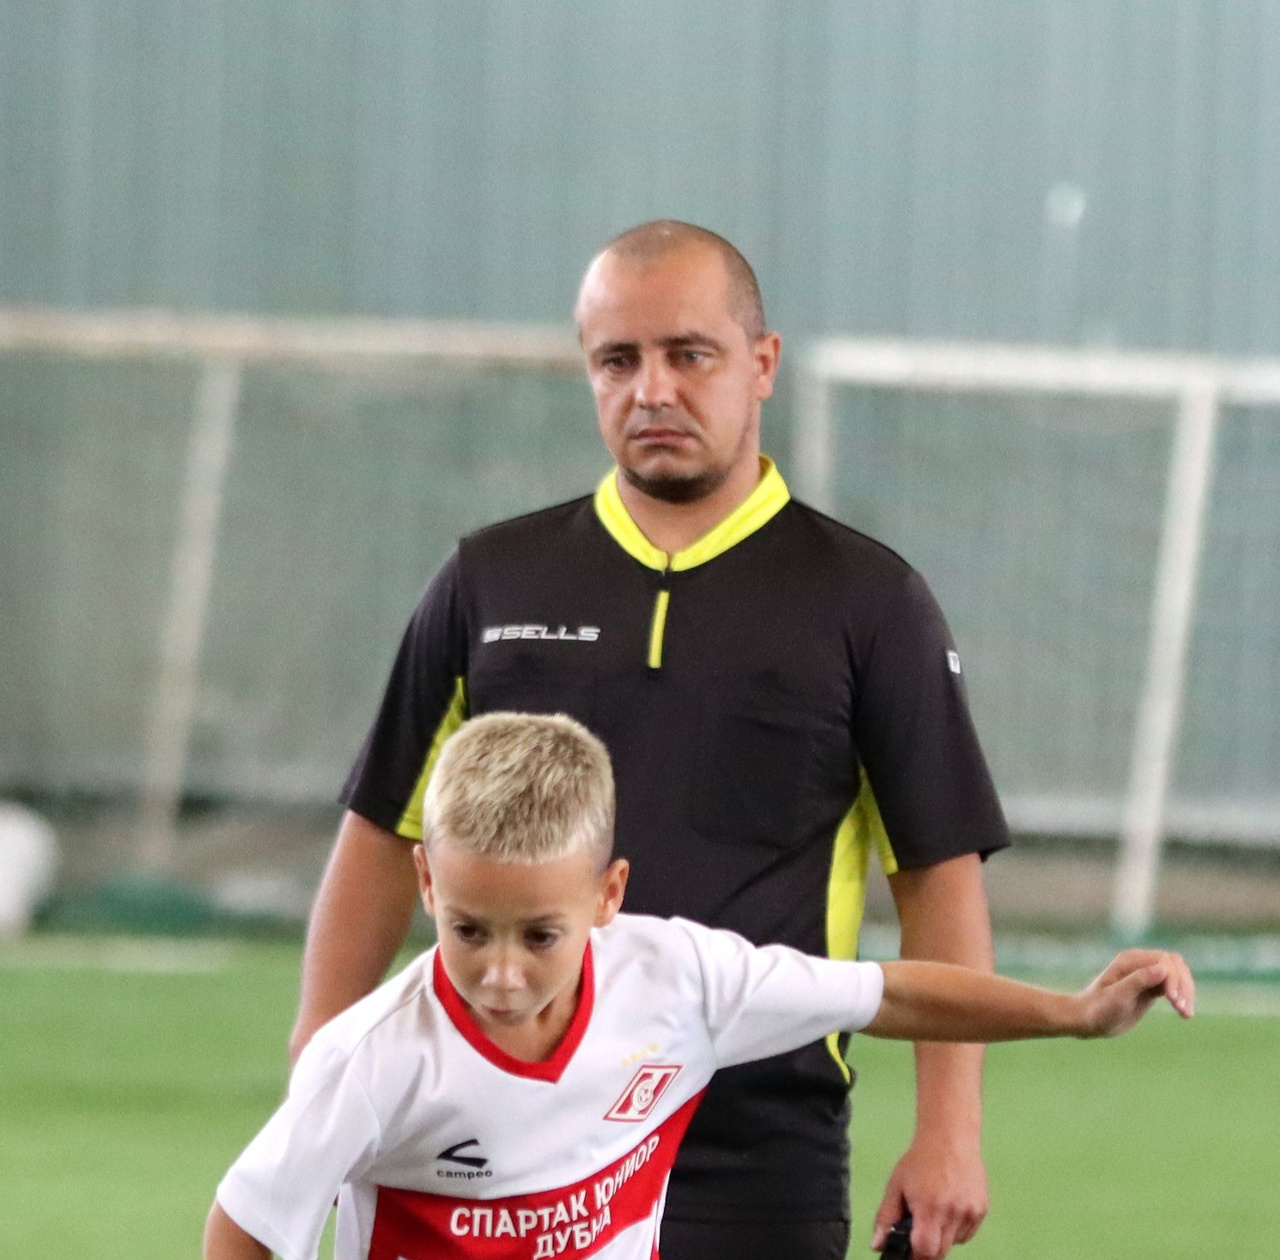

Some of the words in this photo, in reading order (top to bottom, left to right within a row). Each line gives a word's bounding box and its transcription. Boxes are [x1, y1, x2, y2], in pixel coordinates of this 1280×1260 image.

[501, 624, 601, 642] SELLS
[436, 1169, 493, 1181] campeo
[449, 1190, 589, 1239] СПАРТАК
[593, 1133, 661, 1210] ЮНИОР
[532, 1204, 613, 1260] ДУБНА
